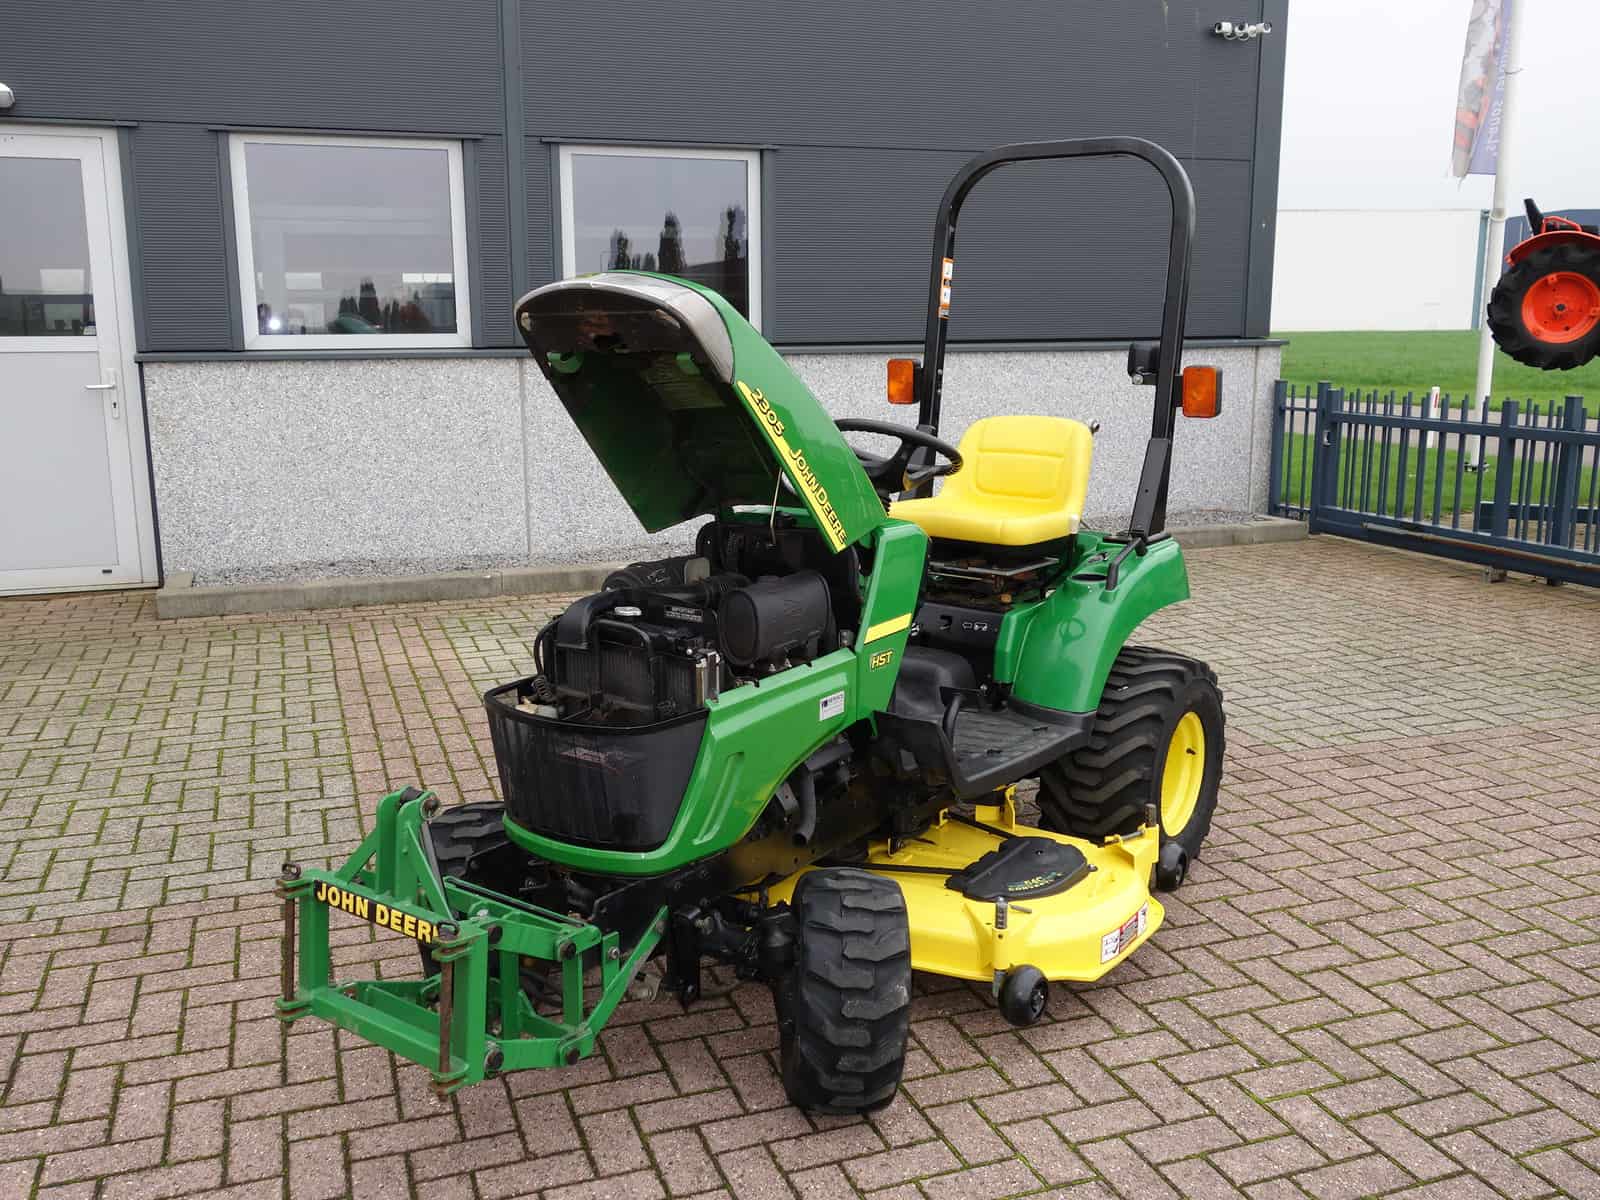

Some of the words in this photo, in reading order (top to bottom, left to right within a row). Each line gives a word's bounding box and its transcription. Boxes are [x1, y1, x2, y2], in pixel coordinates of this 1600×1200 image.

[751, 387, 785, 437] 2305
[790, 449, 819, 494] JOHN
[815, 484, 848, 545] DEERE
[870, 650, 894, 670] HST
[316, 882, 369, 919] JOHN
[375, 902, 440, 944] DEER
